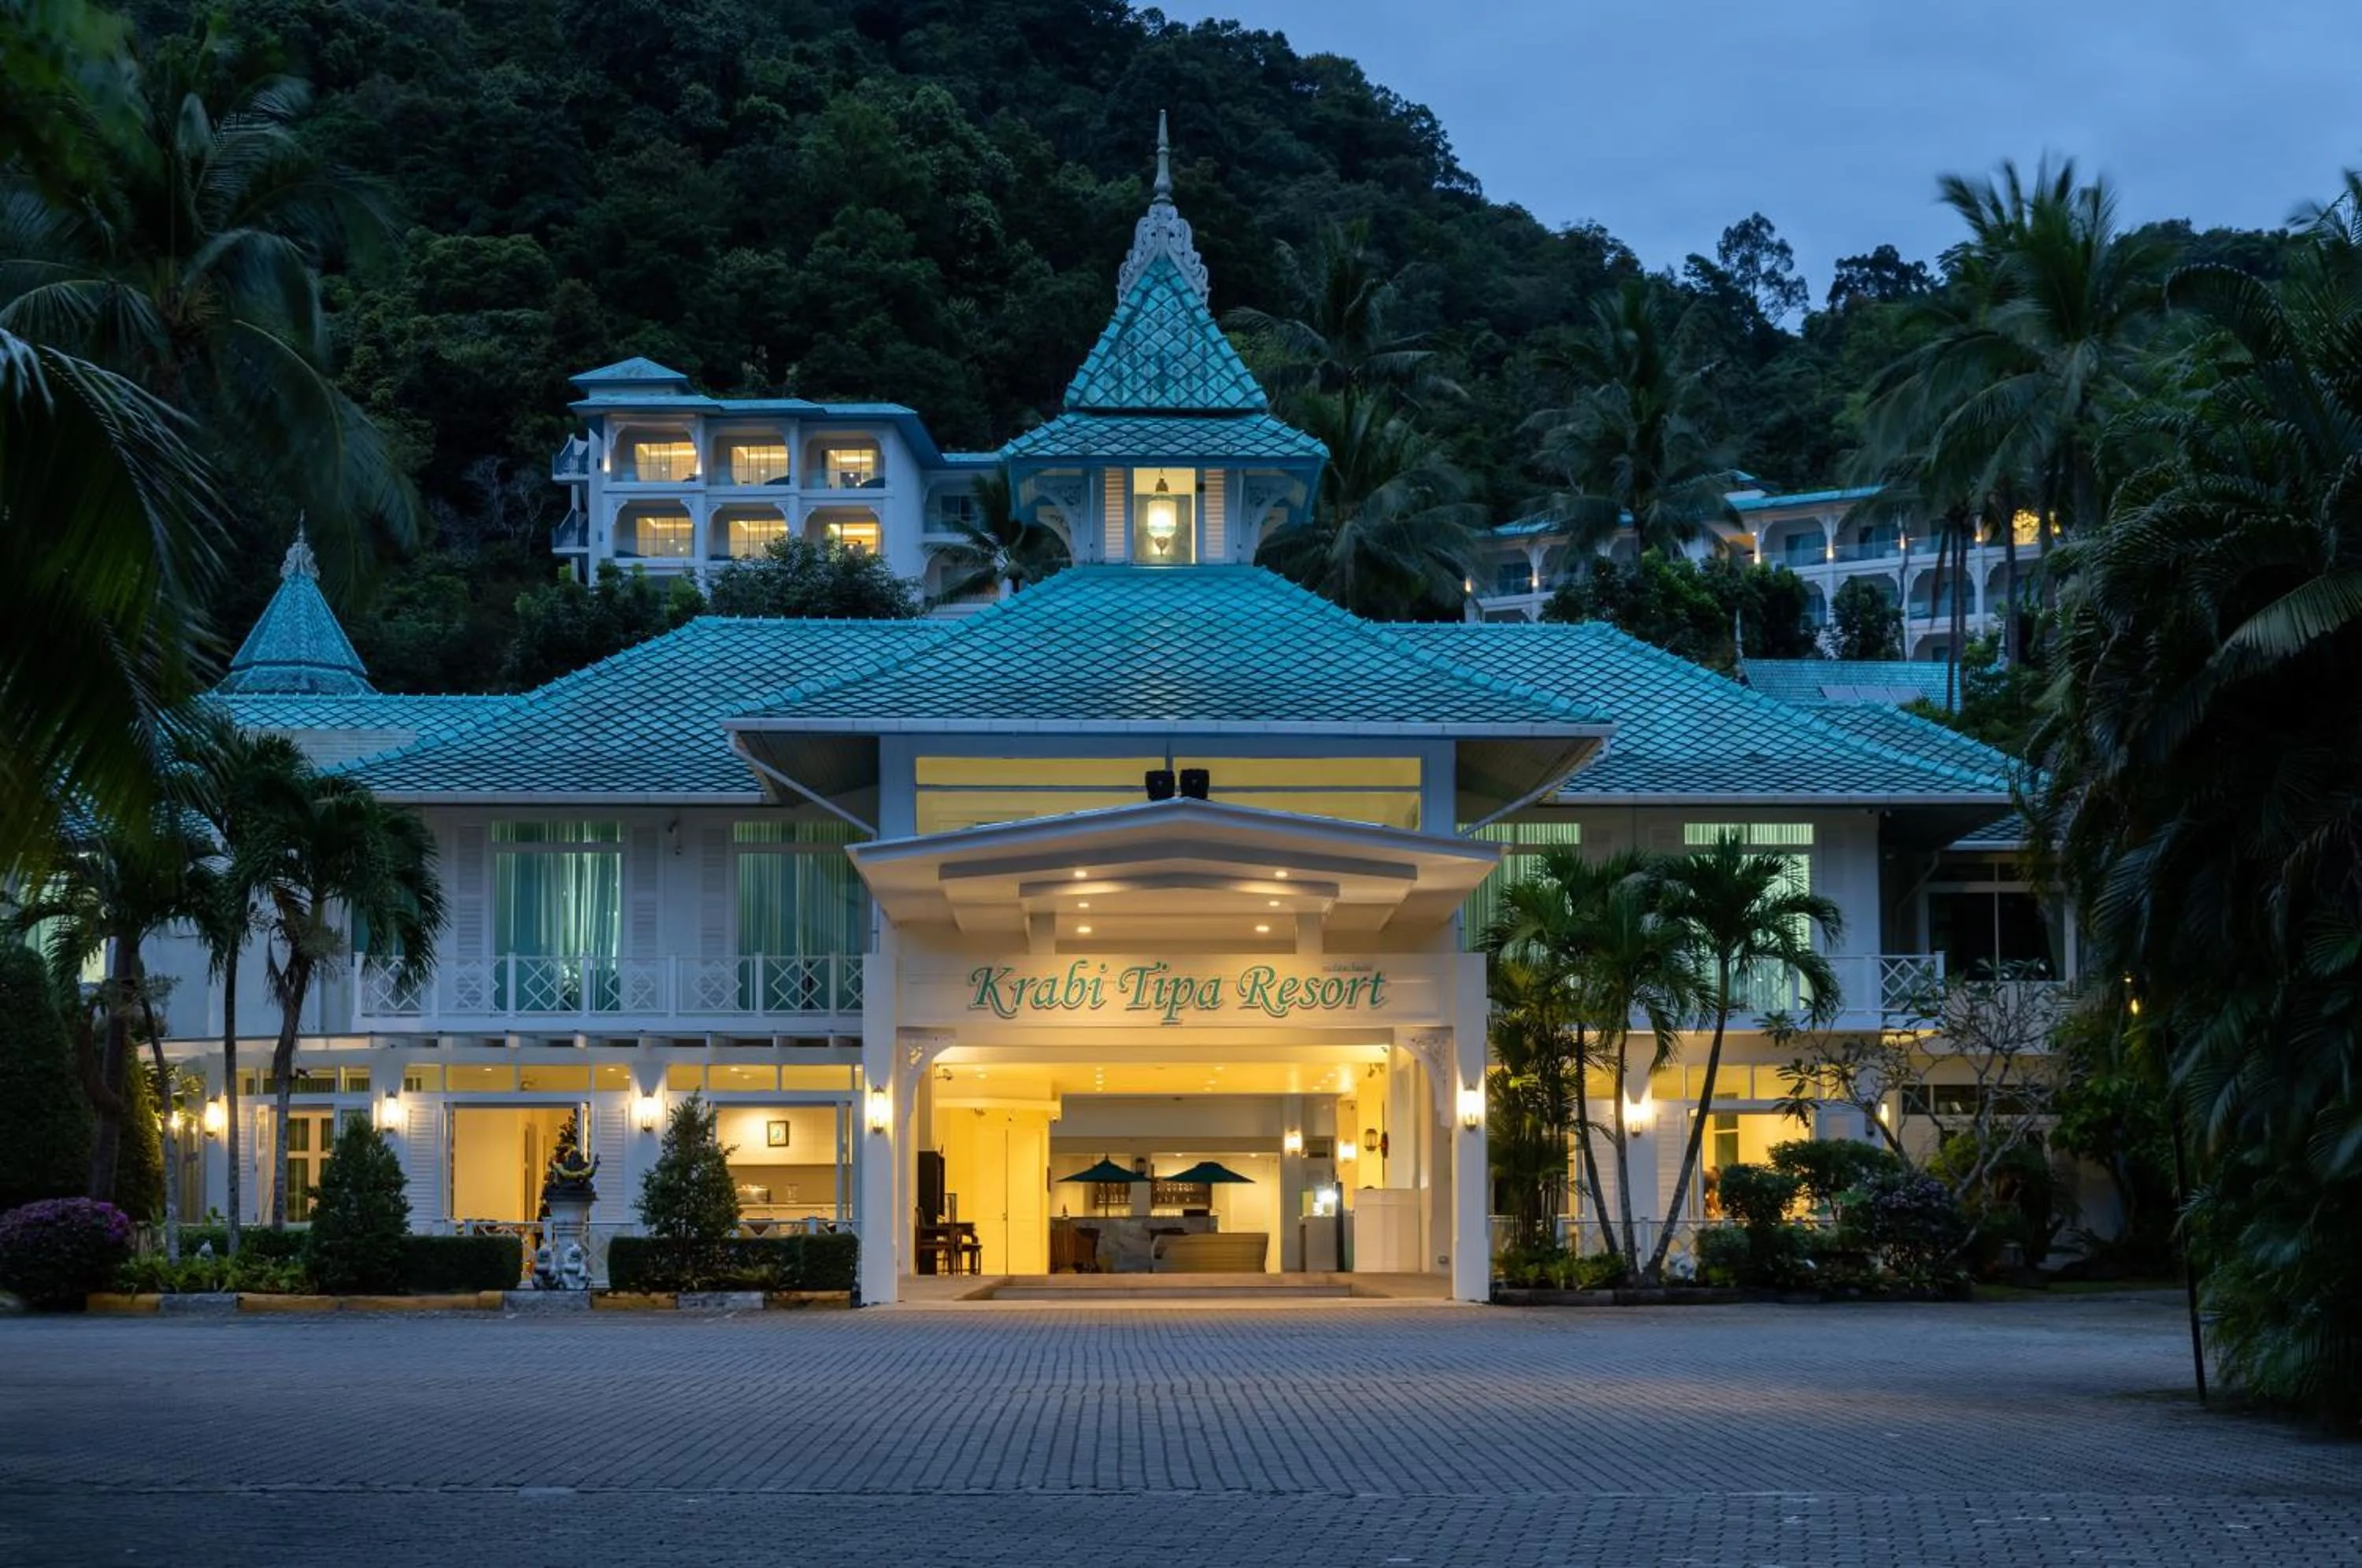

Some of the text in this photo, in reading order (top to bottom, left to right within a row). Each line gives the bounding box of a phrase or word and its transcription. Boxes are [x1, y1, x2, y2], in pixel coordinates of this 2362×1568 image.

[970, 960, 1388, 1025] Krabi Tipa Resort
